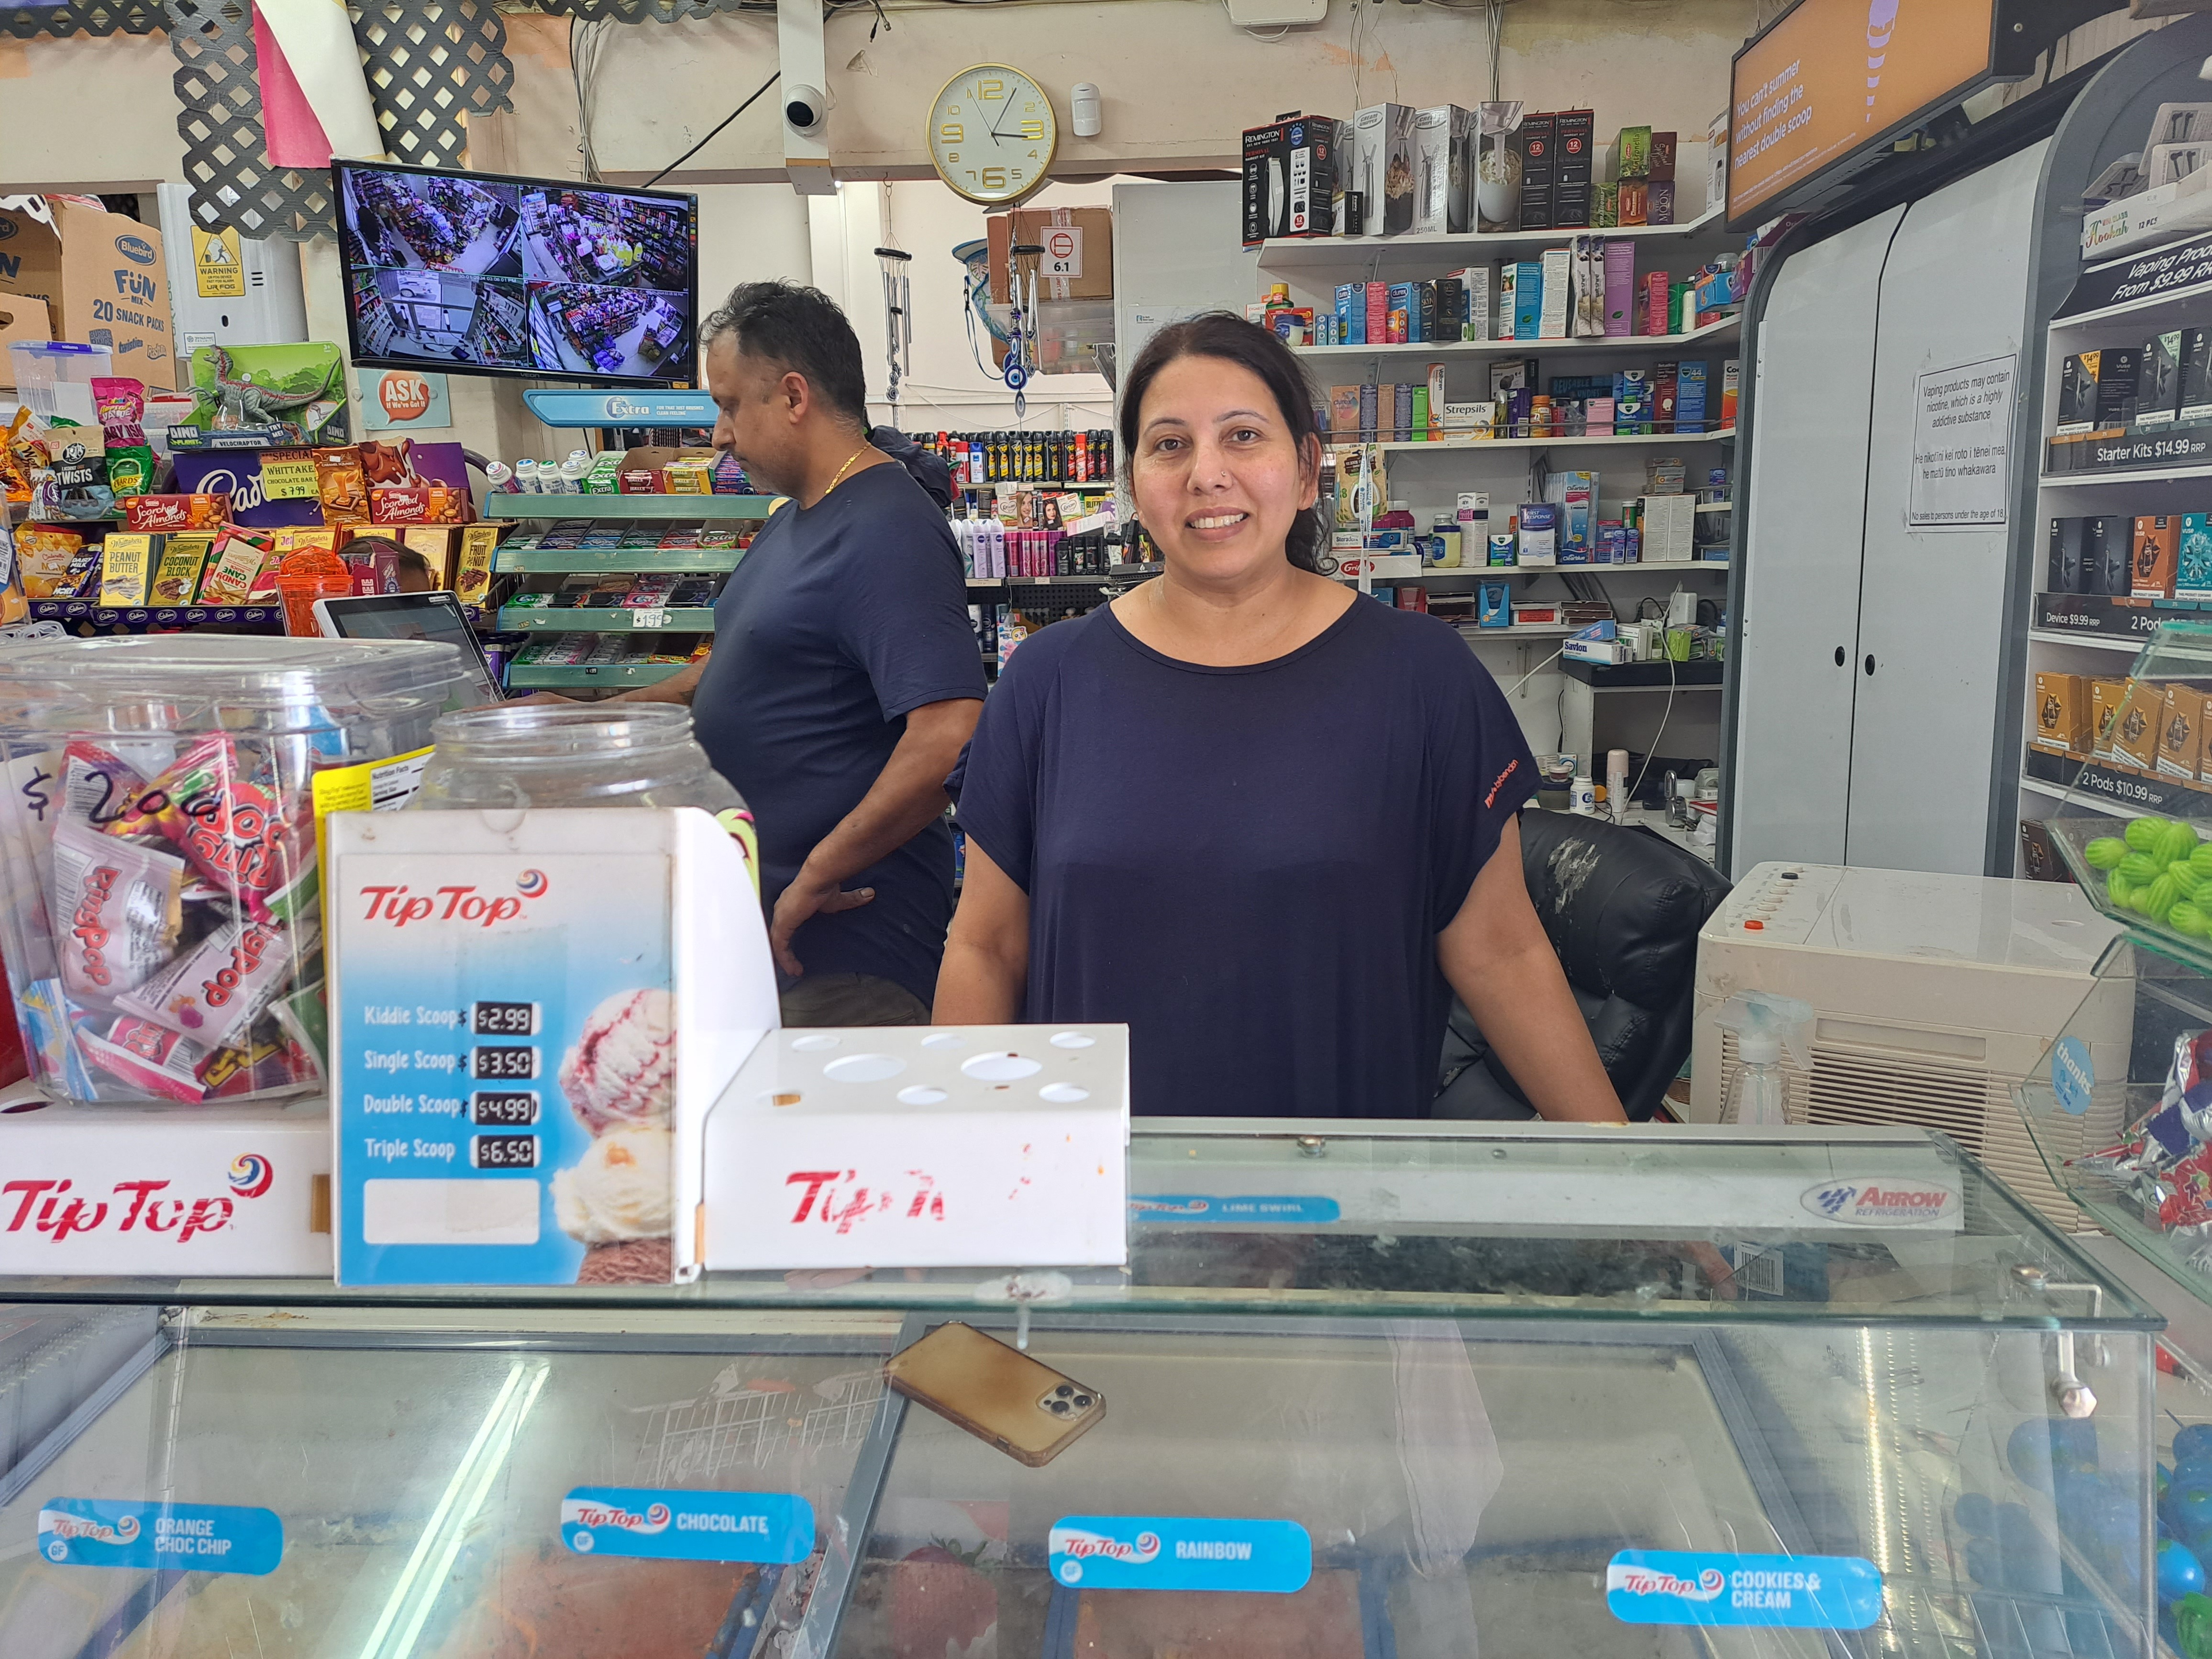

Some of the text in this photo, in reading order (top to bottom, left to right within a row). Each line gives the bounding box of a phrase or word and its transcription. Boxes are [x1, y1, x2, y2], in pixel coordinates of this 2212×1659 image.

[977, 79, 1003, 100] 12
[1737, 58, 1801, 119] You can't summer
[946, 106, 960, 116] 10
[1736, 84, 1803, 144] without finding the
[940, 123, 963, 144] 9
[1021, 120, 1044, 140] 3
[1245, 130, 1281, 144] REMINGTON
[1734, 105, 1813, 169] nearest double scoop
[949, 153, 960, 163] 8
[1027, 149, 1038, 159] 4
[965, 170, 977, 181] 7
[982, 167, 1006, 188] 6
[1011, 169, 1022, 179] 5
[1659, 188, 1668, 222] MOON
[1416, 225, 1437, 234] 250ML
[2086, 219, 2129, 249] Hookah
[121, 241, 153, 259] Bluebird
[1054, 262, 1069, 272] 6.1
[2128, 255, 2178, 279] Vaping
[2111, 280, 2150, 302] From
[2149, 265, 2194, 293] $9.99
[131, 296, 143, 306] MIX
[93, 299, 165, 332] 20 SNACK PACKS
[386, 379, 424, 401] ASK
[1924, 370, 2010, 398] Vaping products may contain
[611, 402, 650, 415] Extra
[1446, 405, 1486, 415] Strepsils
[1926, 398, 1949, 413] nicotine,
[1950, 394, 1968, 408] which
[1969, 394, 1975, 405] is
[1983, 389, 2003, 403] highly
[1932, 409, 1991, 428] addictive substance
[169, 427, 199, 439] DINO
[272, 430, 284, 438] ME!
[1915, 453, 1923, 465] He
[1945, 449, 1954, 461] kei
[1955, 448, 1968, 459] roto
[1969, 448, 1972, 458] i
[1973, 446, 1990, 458] tēnei
[1991, 445, 2006, 457] mea,
[2098, 439, 2206, 462] Starter Kits $14.99 RRP
[56, 468, 93, 486] TWISTS
[1923, 463, 1996, 479] he matū tino whakawara
[592, 485, 612, 494] Extra
[132, 501, 178, 524] Scorched
[138, 509, 187, 530] Almonds
[704, 534, 736, 542] Extra
[109, 552, 142, 562] PEANUT
[469, 545, 487, 557] FRUIT
[109, 563, 139, 574] BUTTER
[164, 556, 199, 566] COCONUT
[473, 556, 486, 567] NUT
[166, 566, 191, 577] BLOCK
[216, 572, 247, 589] CANDY
[223, 567, 247, 581] CANE
[2046, 612, 2100, 627] Device $9.99 RRP
[1565, 641, 1587, 652] Savlon
[373, 765, 409, 780] Nutrition Facts
[2082, 773, 2163, 804] 2 Pods $10.99 RRP
[359, 885, 521, 927] Tip Top
[365, 1006, 410, 1025] Kiddie
[416, 1006, 457, 1027] Scoop
[478, 1009, 531, 1030] $2.99
[365, 1051, 409, 1074] Single
[414, 1051, 455, 1072] Scoop
[478, 1053, 531, 1075] $3.50
[2057, 1041, 2091, 1095] thanks
[365, 1095, 414, 1114] Double
[418, 1095, 460, 1117] Scoop
[478, 1100, 529, 1120] $4.99
[365, 1139, 532, 1164] Triple Scoop $6.50
[1856, 1187, 1948, 1208] ARROW
[2, 1179, 234, 1243] Tip Top
[1222, 1204, 1304, 1213] LIME SWIRL
[1855, 1207, 1940, 1217] REFRIGERATION
[155, 1518, 215, 1537] ORANGE
[577, 1508, 642, 1528] Tip Top
[676, 1512, 769, 1534] CHOCOLATE
[53, 1519, 113, 1539] Tip Top
[155, 1537, 232, 1556] CHOC CHIP
[1065, 1538, 1132, 1559] Tip Top
[1176, 1541, 1252, 1561] RAINBOW
[1626, 1575, 1696, 1596] Tip Top
[1731, 1571, 1821, 1591] COOKIES &
[1731, 1590, 1792, 1608] CREAM
